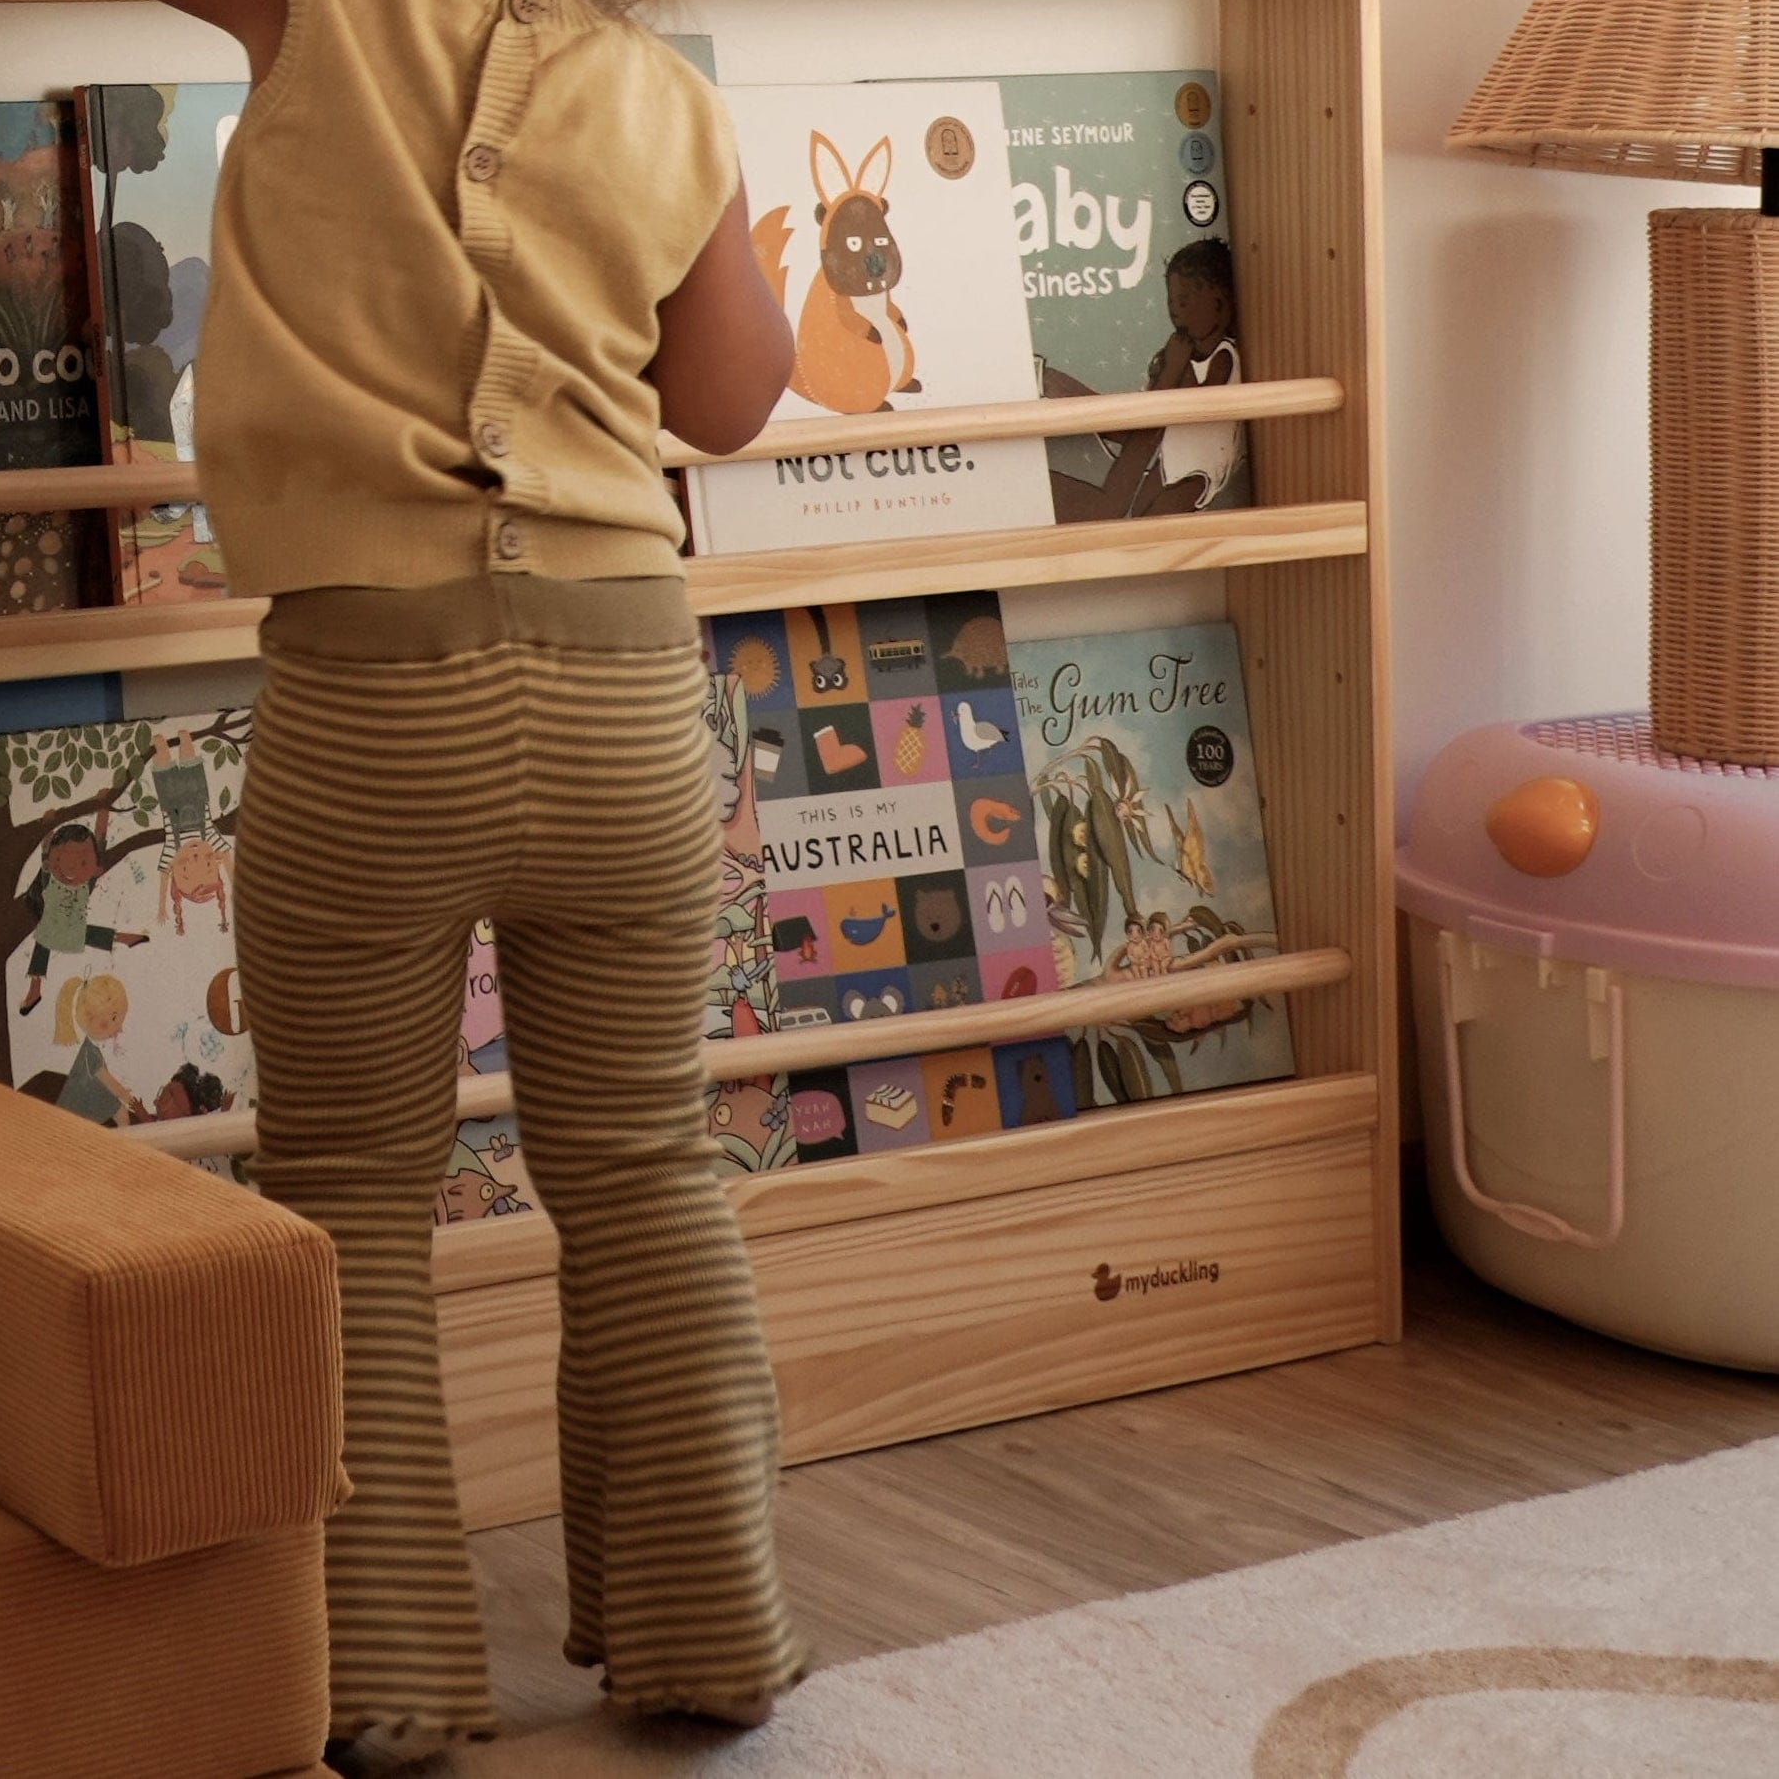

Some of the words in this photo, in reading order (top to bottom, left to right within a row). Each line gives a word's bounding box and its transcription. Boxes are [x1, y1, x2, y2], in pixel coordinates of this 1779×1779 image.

[1006, 128, 1045, 147] INE
[1051, 123, 1135, 145] SEYMOUR
[1012, 165, 1152, 289] aby
[48, 396, 90, 419] LISA
[864, 443, 975, 479] cute.
[802, 500, 861, 515] PHILIP
[873, 493, 952, 511] BUNTING
[1016, 697, 1043, 717] The
[1042, 663, 1139, 746] Gum
[1149, 653, 1228, 713] Tree
[1196, 744, 1225, 760] 100
[798, 808, 837, 824] THIS
[849, 805, 864, 818] IS
[876, 801, 897, 814] MY
[762, 825, 948, 873] AUSTRALIA
[1125, 1260, 1219, 1295] myduckling
